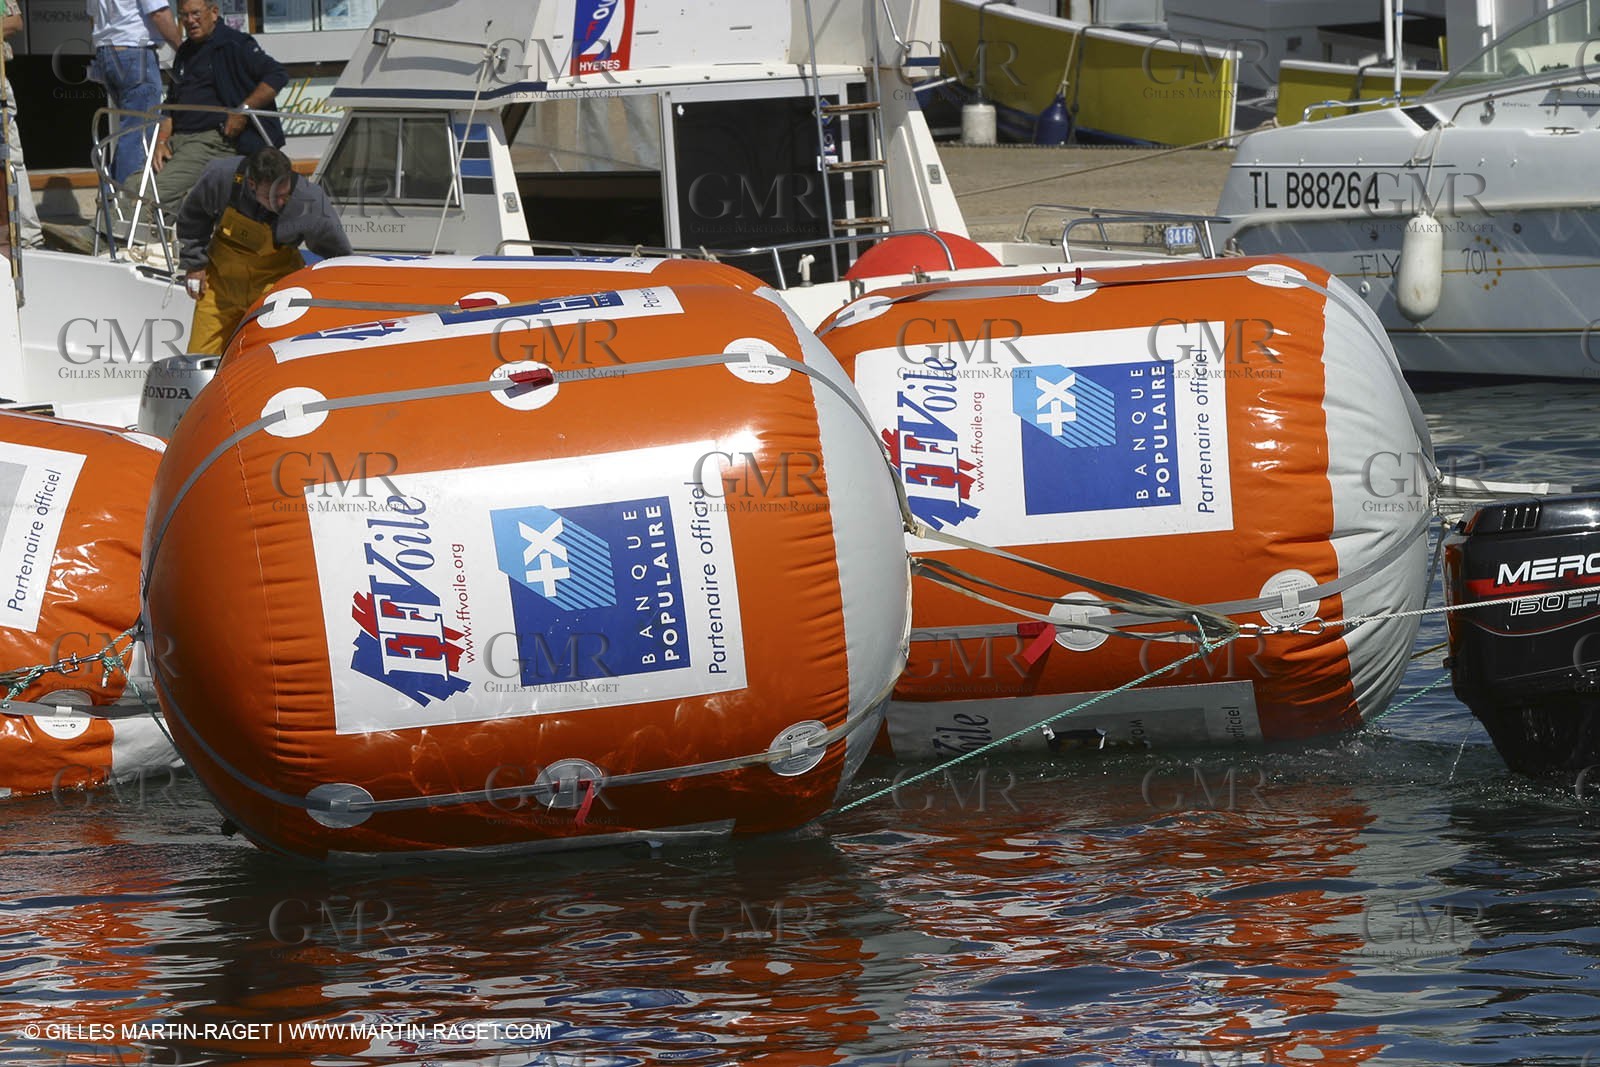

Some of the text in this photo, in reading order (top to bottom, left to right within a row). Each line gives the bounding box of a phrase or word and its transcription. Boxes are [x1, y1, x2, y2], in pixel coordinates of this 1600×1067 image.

[579, 60, 621, 71] HYERES
[1167, 228, 1194, 244] 3416
[1249, 171, 1380, 209] TL B88264
[970, 391, 985, 493] www.ffvoile.org
[1130, 368, 1149, 500] BANQUE
[1151, 365, 1172, 498] POPULAIRE
[1188, 349, 1215, 514] Partenaire officiel
[7, 468, 62, 612] Partenaire officiel
[451, 543, 476, 664] www.ffvoile.org
[622, 510, 656, 665] BANQUE
[645, 504, 680, 662] POPULAIRE
[684, 481, 728, 674] Partenaire officiel
[1509, 593, 1565, 616] 150
